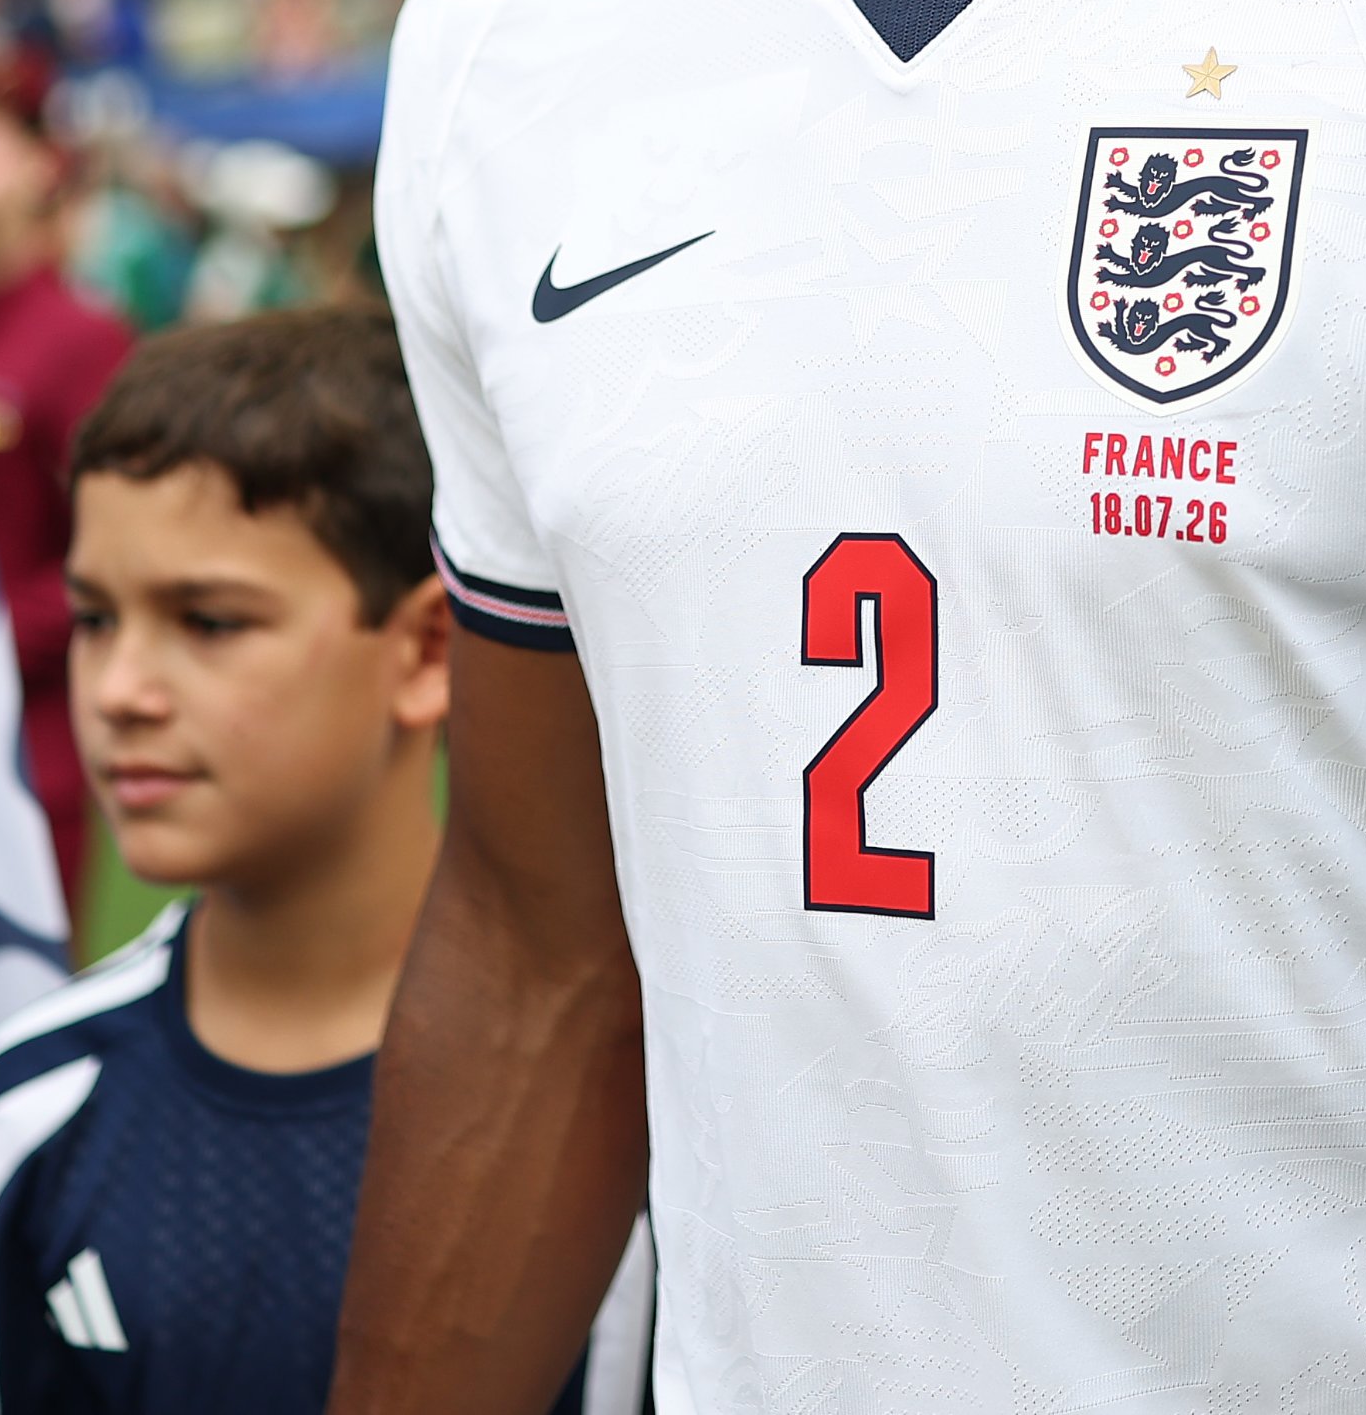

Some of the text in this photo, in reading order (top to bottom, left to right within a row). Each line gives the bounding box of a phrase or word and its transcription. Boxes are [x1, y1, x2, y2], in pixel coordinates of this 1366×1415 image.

[1083, 432, 1238, 484] FRANCE
[1090, 492, 1227, 544] 18.07.26
[801, 532, 938, 920] 2
